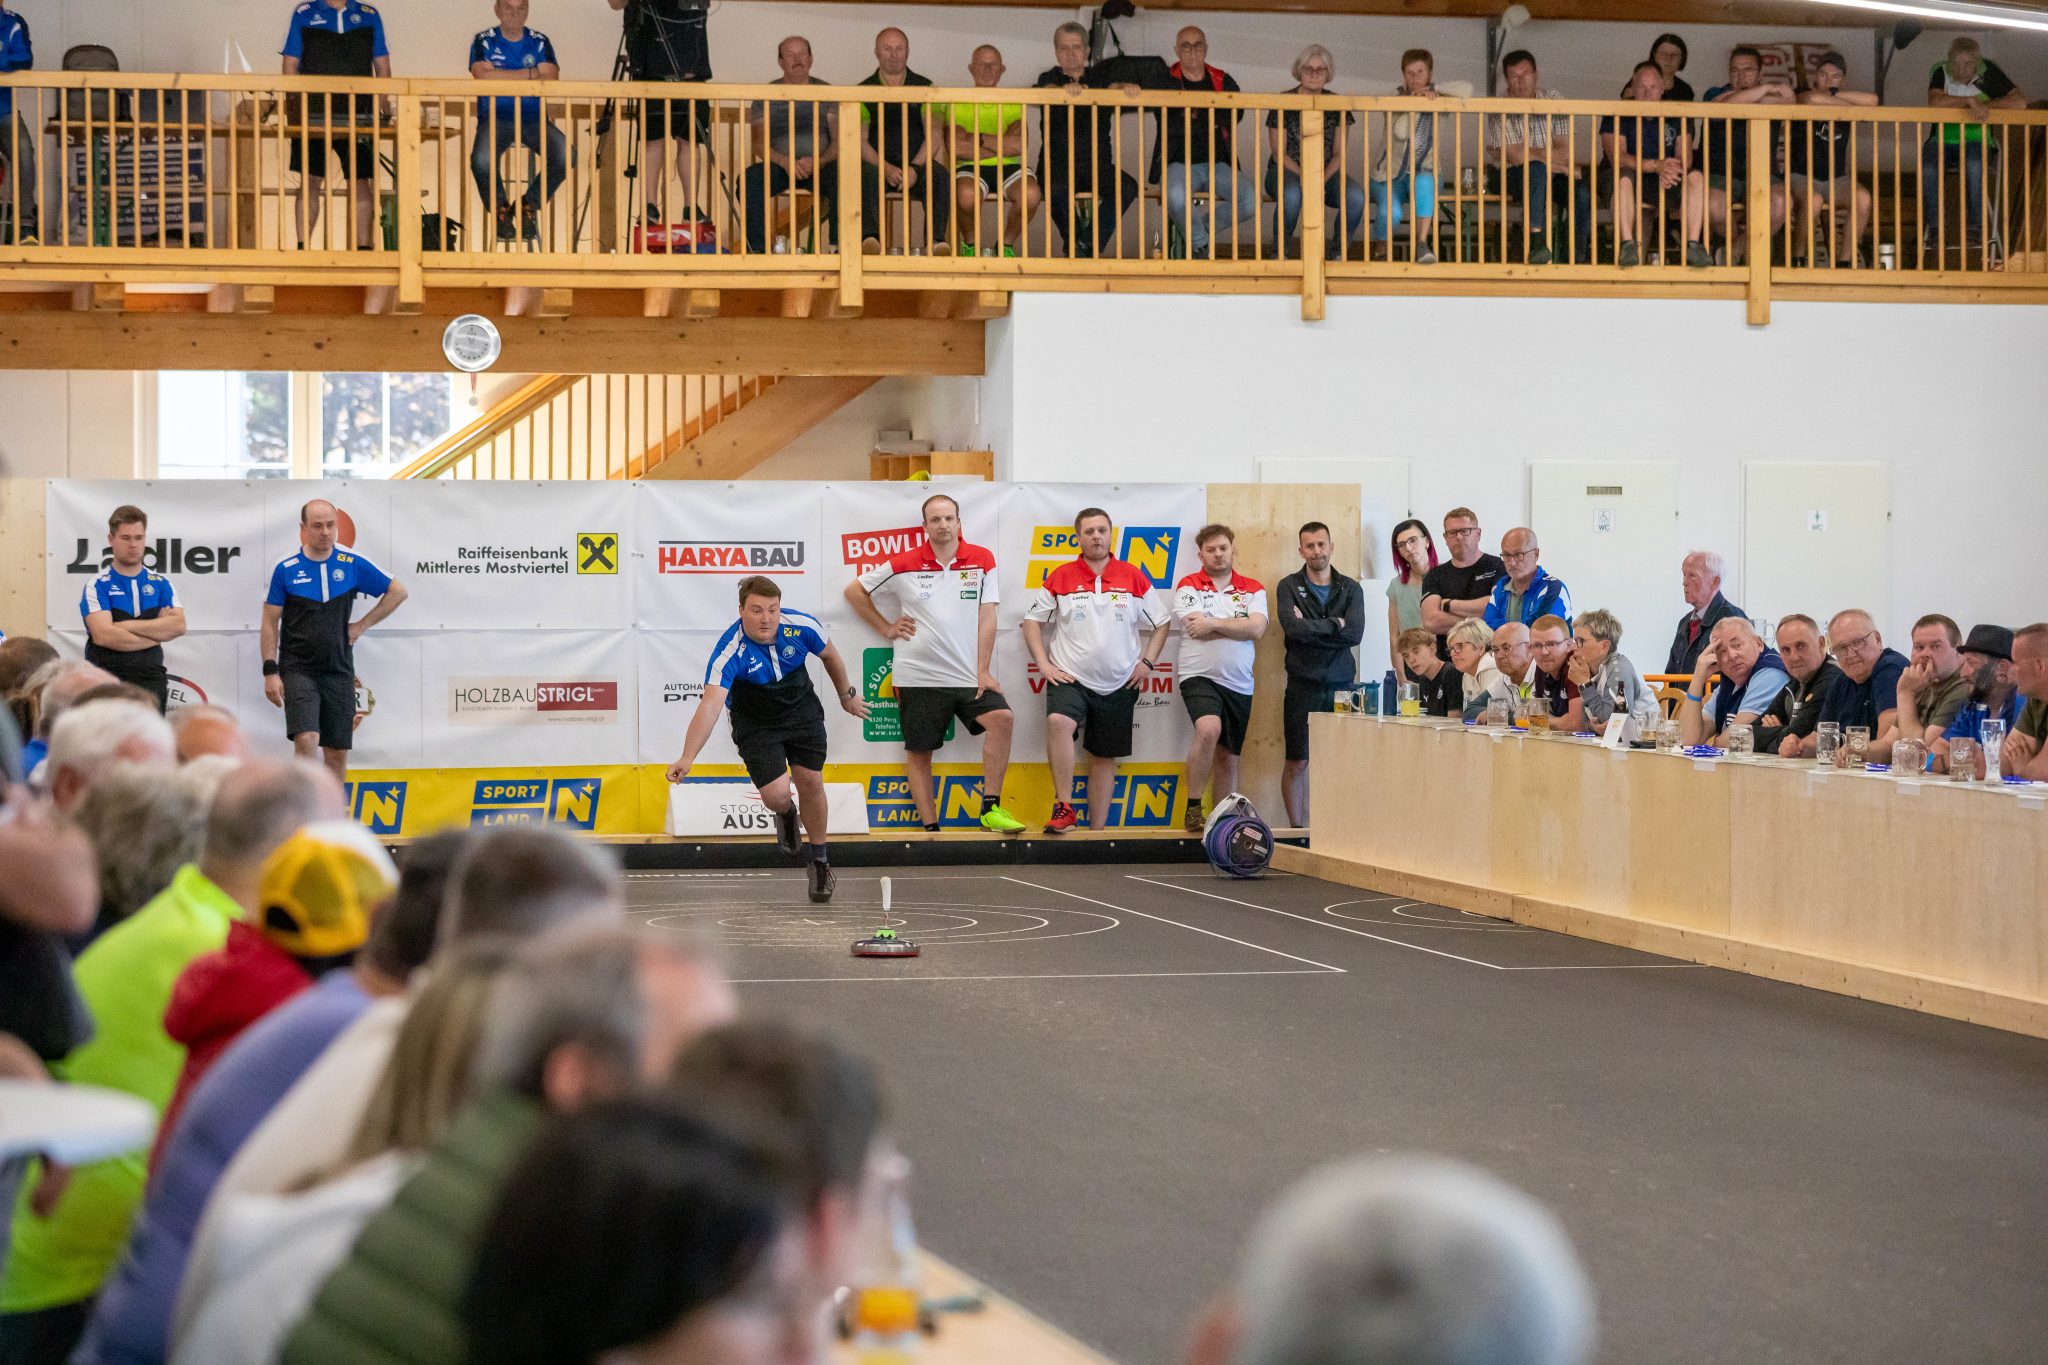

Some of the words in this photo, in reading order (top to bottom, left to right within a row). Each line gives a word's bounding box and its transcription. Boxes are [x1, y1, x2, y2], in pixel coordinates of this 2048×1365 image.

[1598, 523, 1610, 531] WC
[1811, 523, 1823, 531] WC
[847, 531, 930, 559] BOWLI
[1041, 533, 1079, 548] SPO
[458, 546, 569, 559] Raiffeisenbank
[416, 561, 481, 574] Mittleres
[486, 561, 569, 574] Mostviertel
[868, 659, 893, 690] SÜDS
[663, 683, 705, 691] AUTOHA
[870, 700, 899, 709] Gasthau
[481, 785, 540, 799] SPORT
[876, 781, 911, 794] SPO
[720, 804, 770, 814] STOCK
[877, 809, 921, 822] LAND
[483, 813, 530, 827] LAND
[722, 813, 778, 830] AUST
